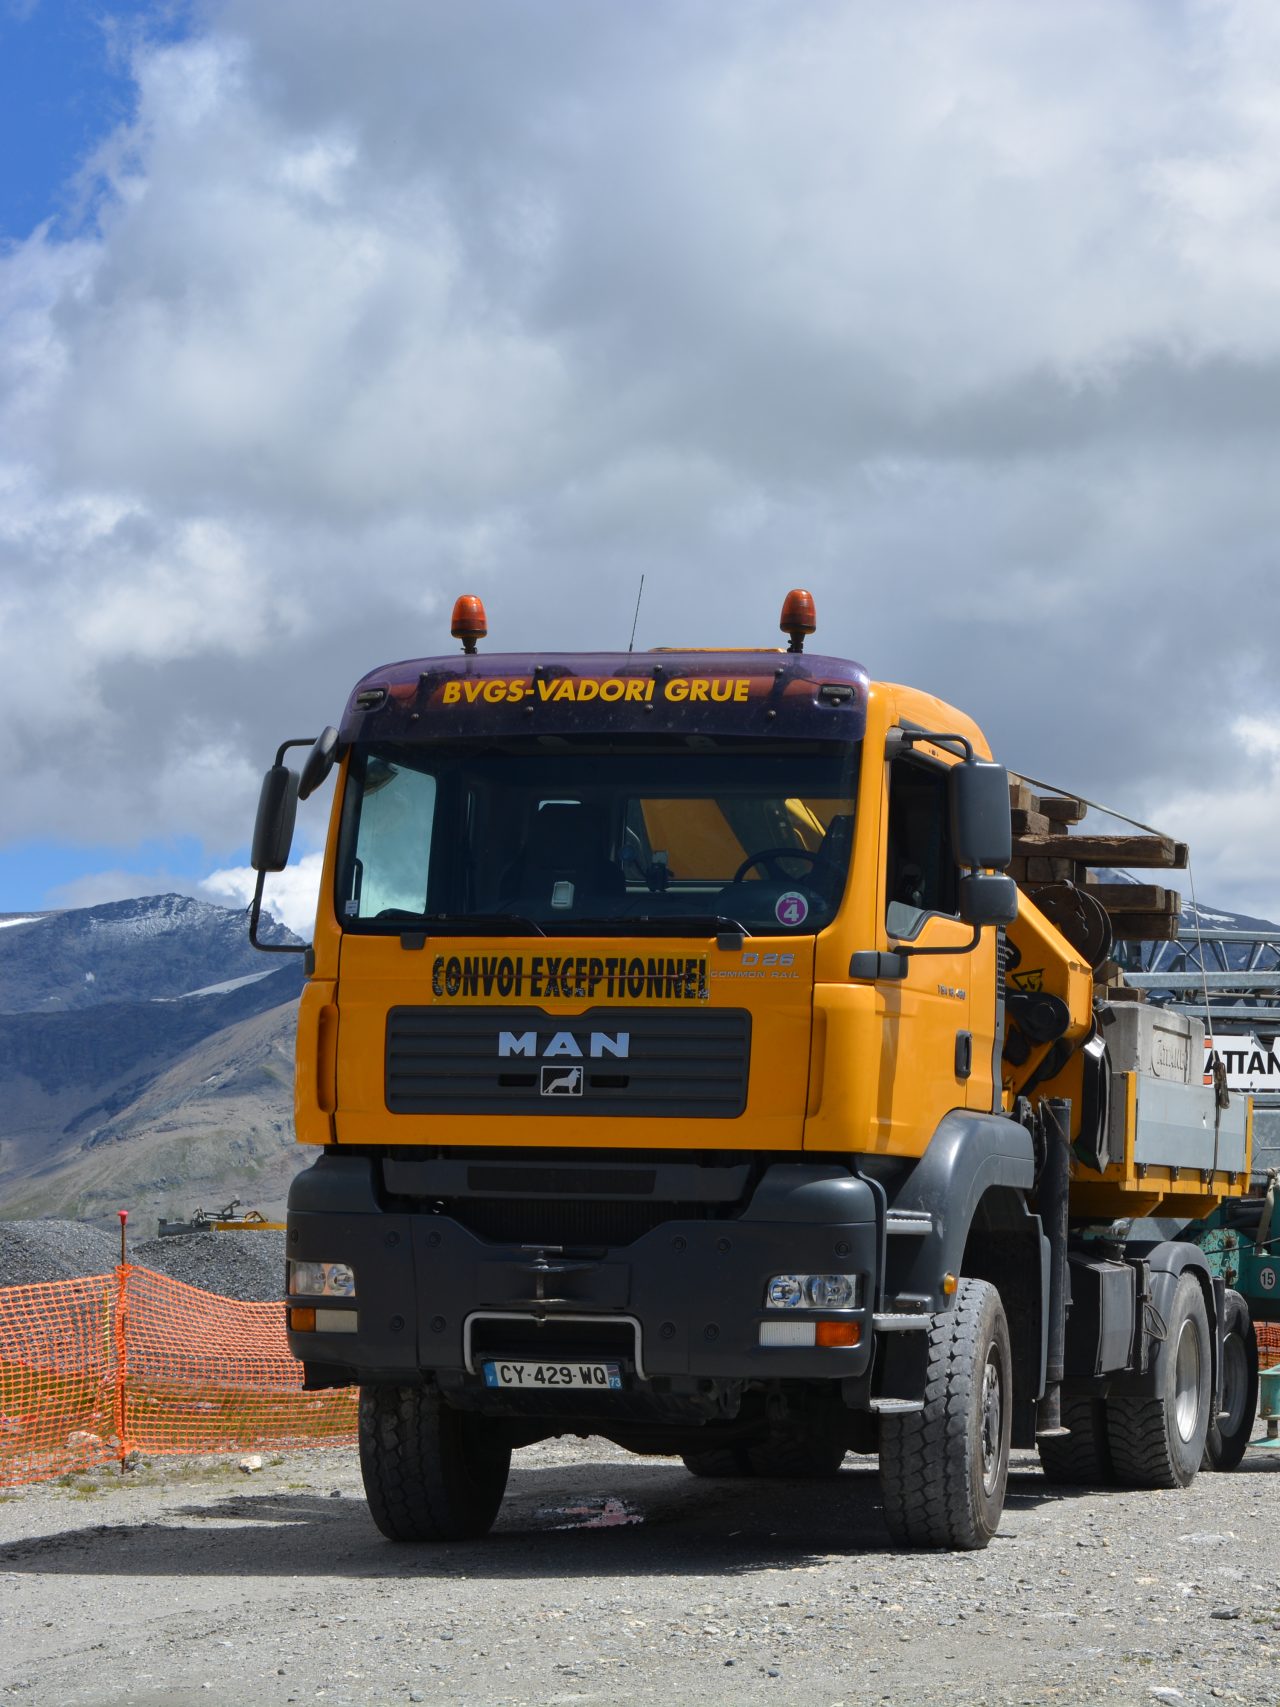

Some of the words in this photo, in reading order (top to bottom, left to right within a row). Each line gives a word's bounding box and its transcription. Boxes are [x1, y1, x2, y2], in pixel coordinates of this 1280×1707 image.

[442, 679, 656, 703] BVGS-VADORI
[664, 679, 750, 702] GRUE
[783, 903, 800, 921] 4
[762, 953, 795, 966] 26
[432, 956, 523, 997] CONVOI
[530, 956, 710, 999] EXCEPTIONNEL
[710, 970, 766, 978] COMMON
[771, 971, 800, 979] RAIL
[498, 1031, 630, 1058] MAN
[1261, 1272, 1274, 1286] 15
[500, 1364, 608, 1385] CY-429-WQ
[608, 1377, 622, 1387] 73
